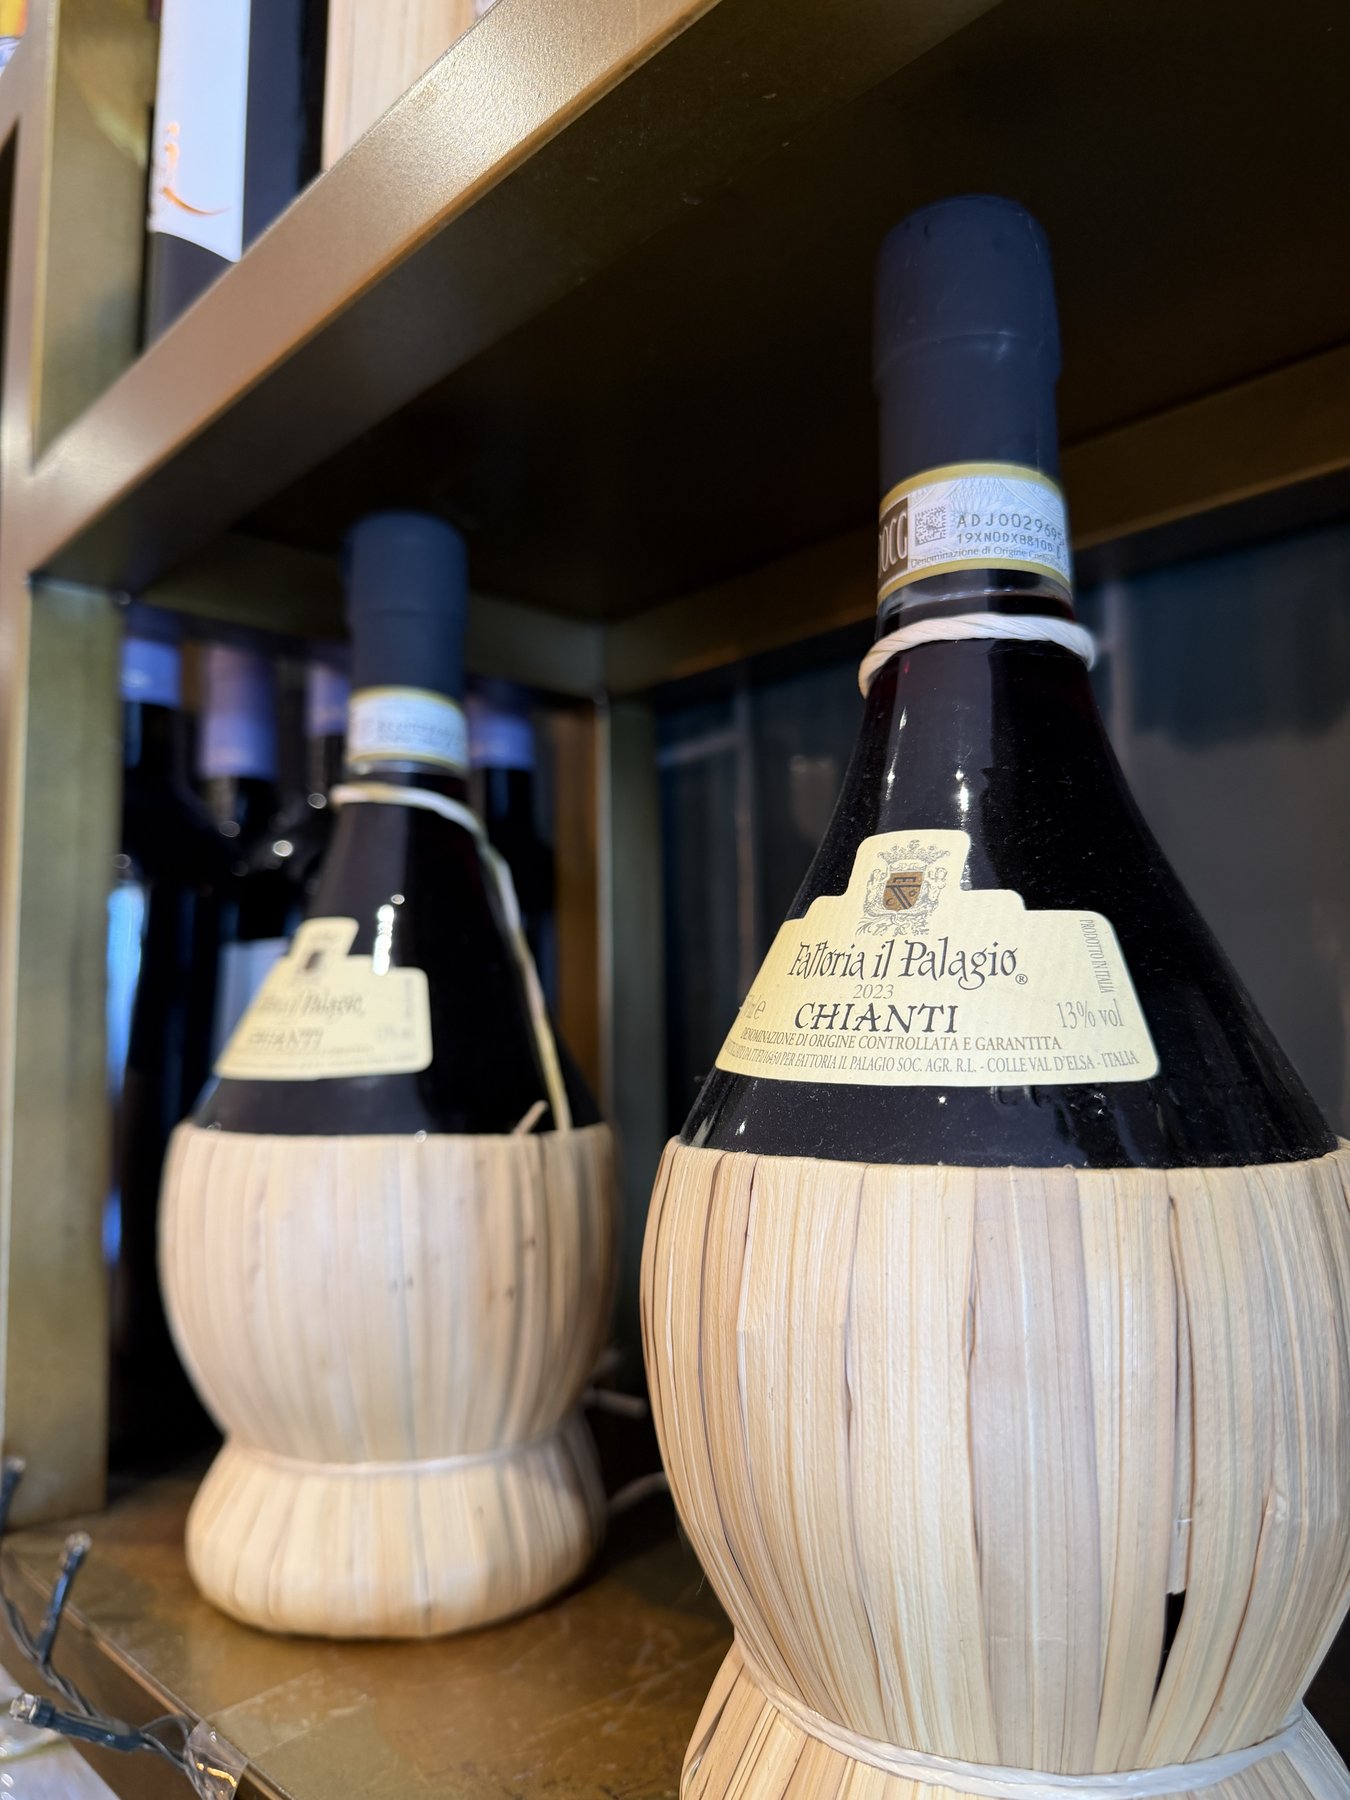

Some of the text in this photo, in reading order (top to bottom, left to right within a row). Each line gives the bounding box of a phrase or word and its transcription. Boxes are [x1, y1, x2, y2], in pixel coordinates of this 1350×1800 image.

[911, 546, 1028, 568] Denominazione di Origine
[787, 940, 865, 980] Fattoria
[870, 939, 895, 980] il
[853, 984, 894, 999] 2023
[794, 1002, 958, 1033] CHIANTI
[1056, 998, 1125, 1029] 13% vol
[740, 1027, 1063, 1052] DENOMINAZIONE DI ORIGINE CONTROLLATA E GARANTITA
[779, 1052, 795, 1067] PER
[795, 1053, 836, 1069] FATTORIA
[837, 1056, 847, 1070] IL
[849, 1056, 895, 1072] PALAGIO
[897, 1057, 922, 1072] SOC.
[925, 1057, 953, 1072] AGR.
[956, 1057, 977, 1072] R.L.
[987, 1057, 1027, 1073] COLLE
[1029, 1057, 1052, 1072] VAL
[1054, 1055, 1094, 1072] D'ELSA
[1101, 1050, 1139, 1068] ITALIA
